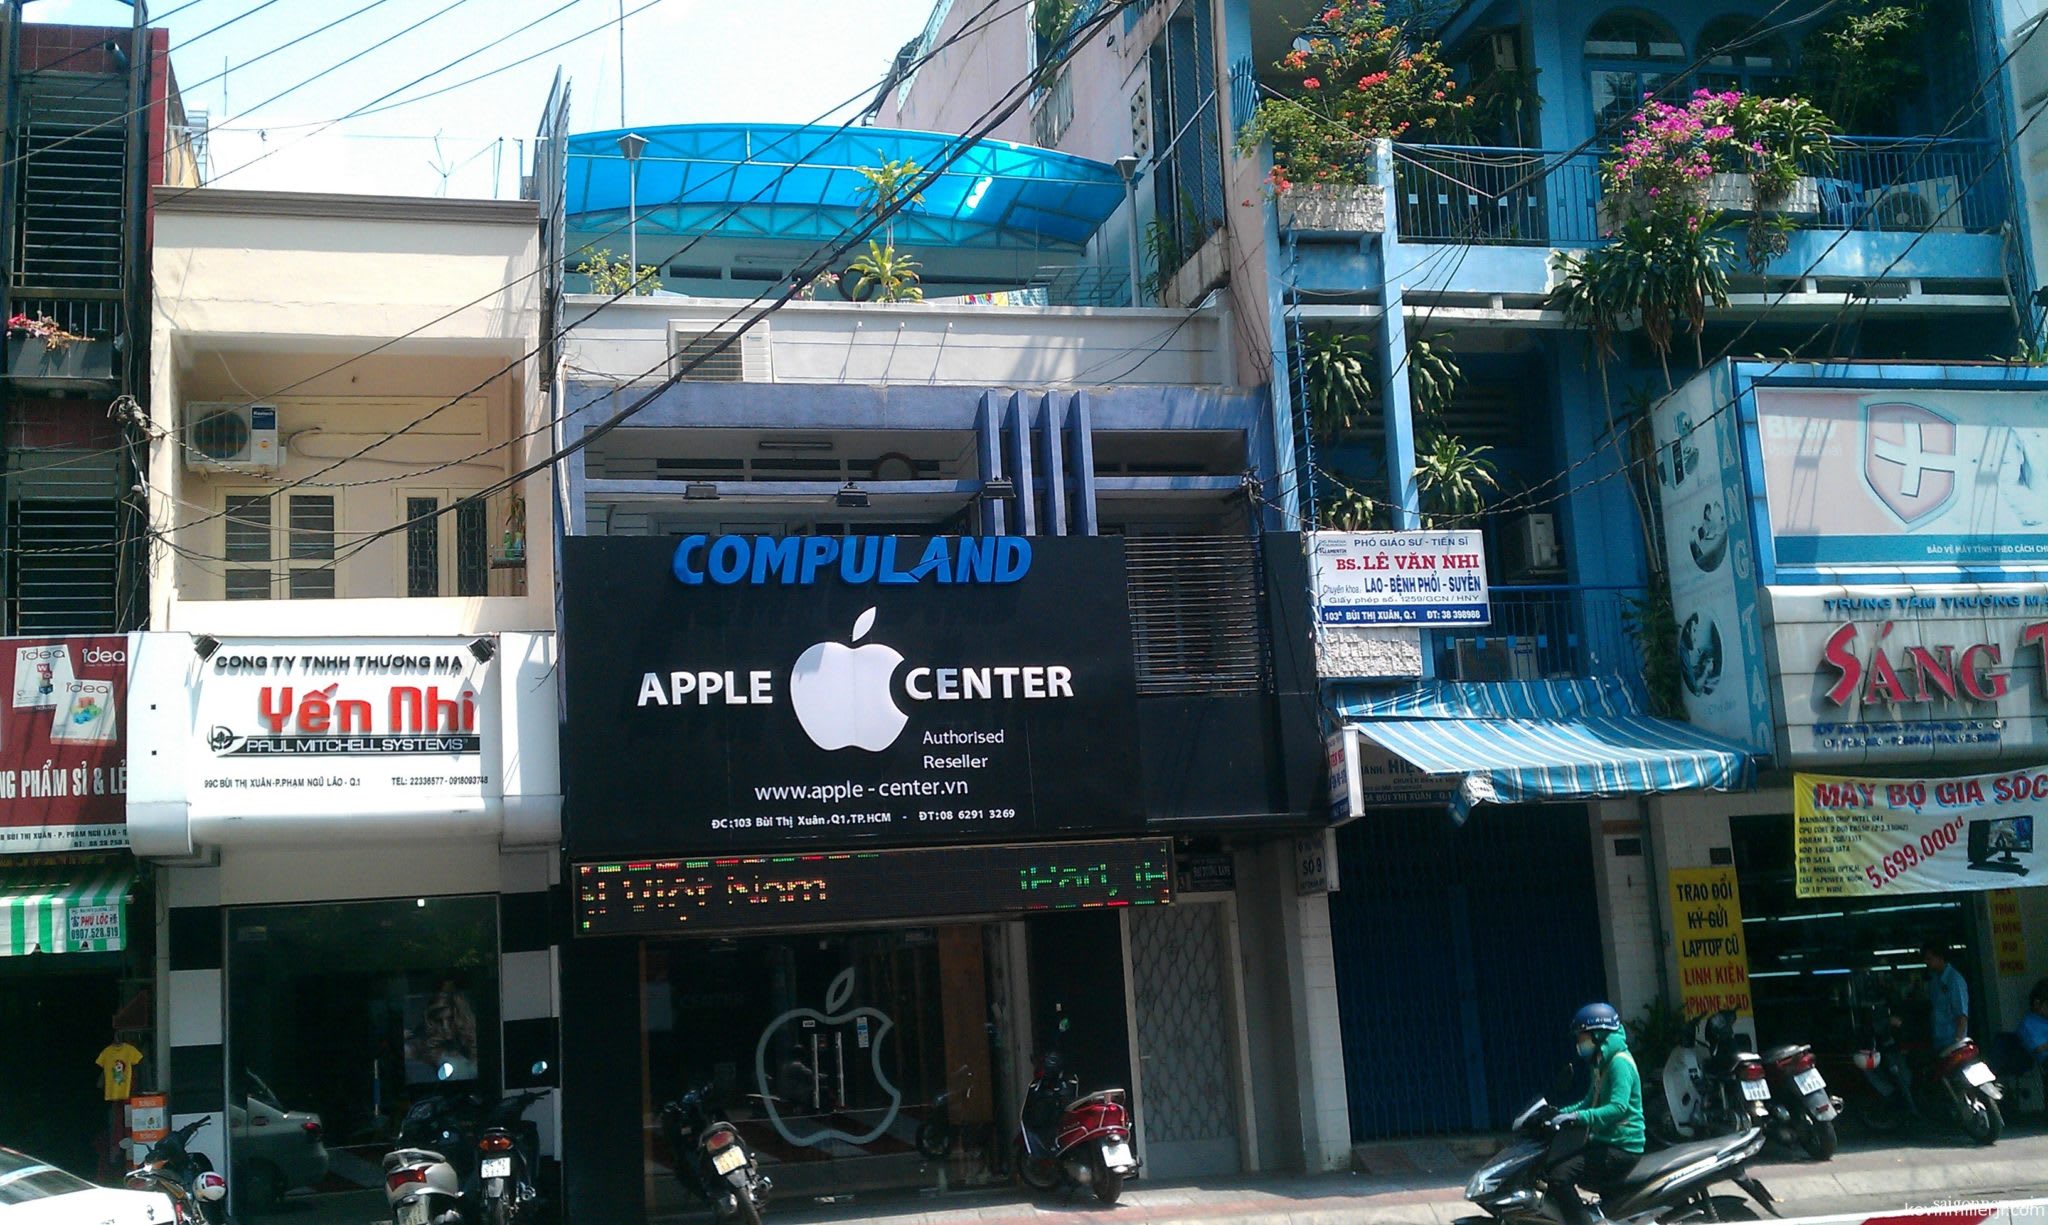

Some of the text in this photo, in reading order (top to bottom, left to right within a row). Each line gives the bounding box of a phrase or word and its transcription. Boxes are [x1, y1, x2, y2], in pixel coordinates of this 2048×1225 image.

[1354, 537, 1376, 547] PHÓ
[1379, 537, 1405, 547] GIÁO
[1408, 537, 1422, 546] SƯ
[1993, 545, 2013, 553] THEO
[2014, 544, 2035, 553] CÁCH
[673, 535, 1032, 586] COMPULAND
[1394, 552, 1436, 570] VĂN
[1442, 554, 1480, 569] NHI
[1365, 577, 1383, 592] LAO
[1390, 574, 1416, 596] BỆNH
[1824, 598, 1892, 610] TRUNG
[1404, 610, 1416, 620] Q.1
[21, 648, 66, 661] idea
[82, 646, 126, 663] idea
[272, 656, 296, 668] TY
[301, 656, 351, 668] TNHH
[355, 654, 431, 668] THƯƠNG
[1825, 620, 2010, 706] SÁNG
[66, 682, 109, 694] idea
[637, 665, 1075, 706] APPLE CENTER
[261, 683, 474, 733] Yến Nhi
[247, 738, 464, 752] PAUL MITCHELL SYSTEMS
[922, 729, 1005, 745] Authorised
[923, 754, 989, 769] Reseller
[21, 759, 67, 798] PHẨM
[72, 760, 88, 796] SỈ
[93, 767, 105, 795] &
[110, 759, 127, 794] LẺ
[391, 777, 408, 786] TEL:
[712, 818, 752, 829] ĐC:103
[756, 815, 773, 827] Bùi
[775, 815, 793, 828] Thị
[958, 809, 984, 820] 6291
[989, 808, 1016, 819] 3269
[1676, 883, 1708, 902] TRAO
[1682, 938, 1722, 958] LAPTOP
[1684, 967, 1712, 986] LINH
